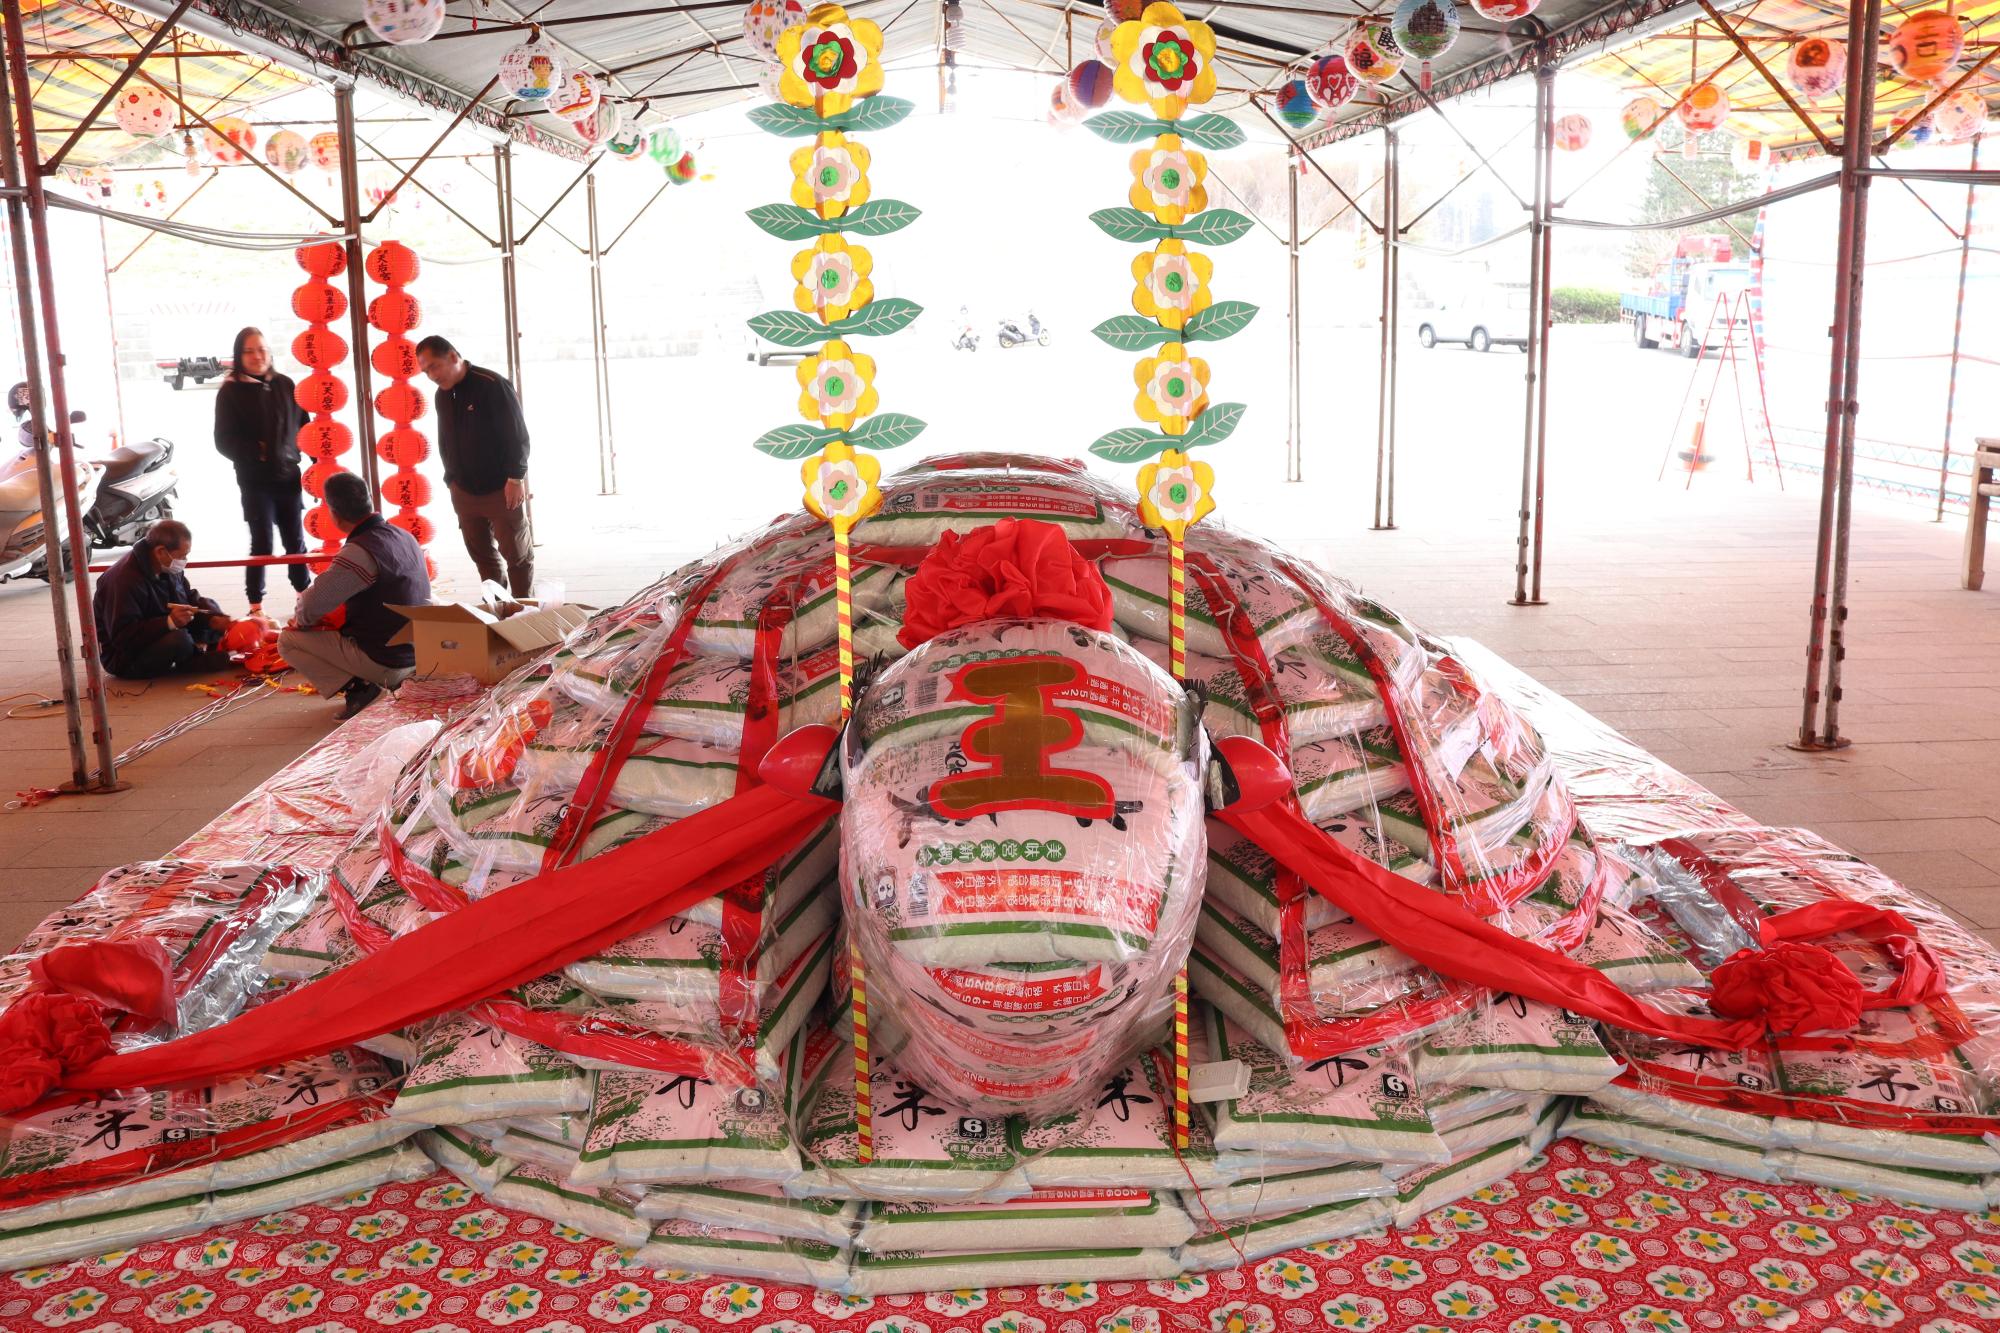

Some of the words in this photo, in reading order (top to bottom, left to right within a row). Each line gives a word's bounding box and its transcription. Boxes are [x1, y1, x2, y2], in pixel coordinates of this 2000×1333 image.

[936, 659, 1109, 813] 王
[1387, 1075, 1404, 1092] 6
[742, 1089, 760, 1107] 6
[878, 1081, 947, 1131] 米
[81, 1109, 149, 1150] 米
[166, 1128, 186, 1140] 6
[964, 1119, 983, 1133] 6
